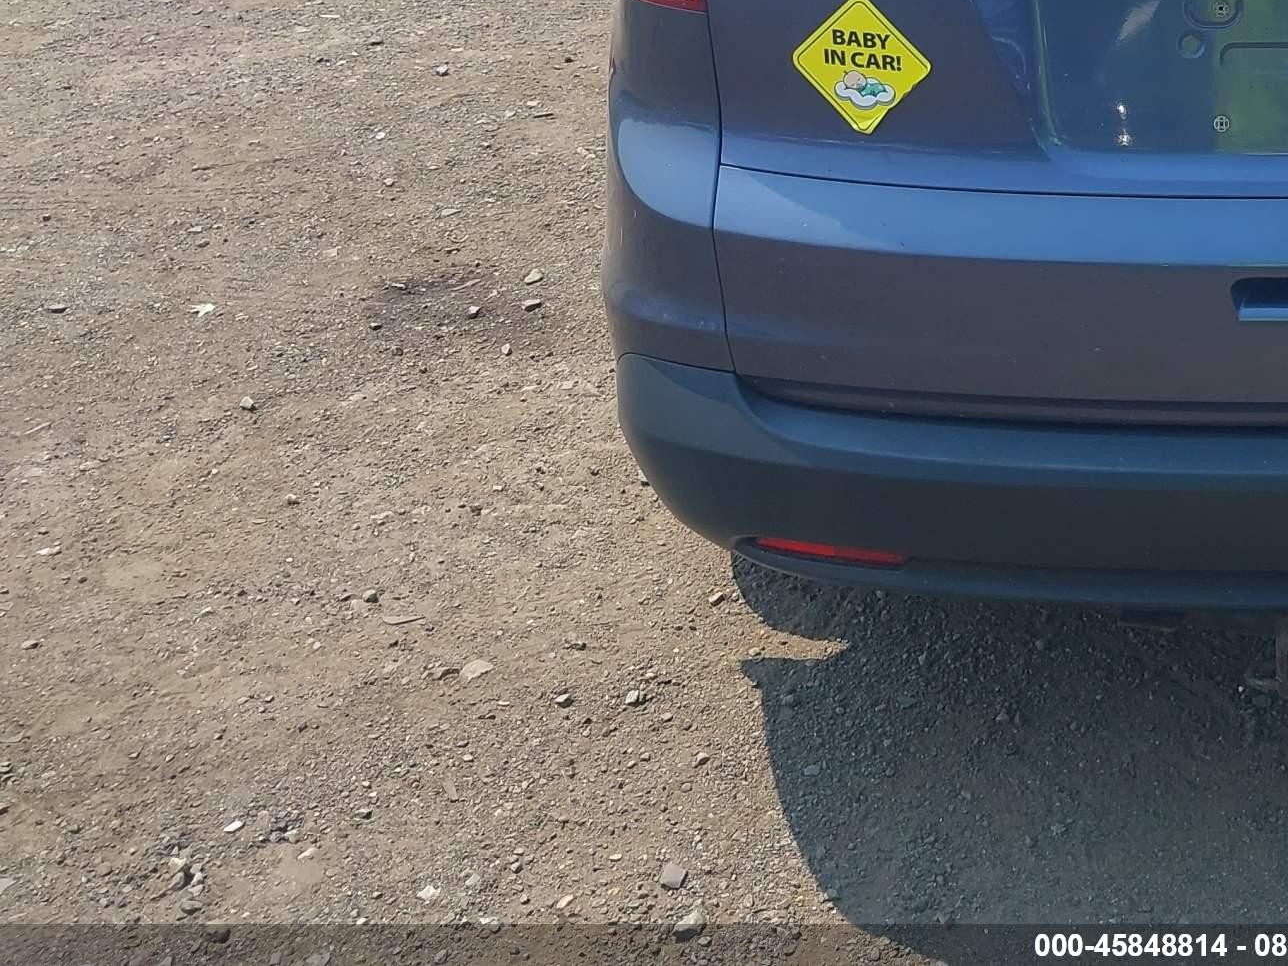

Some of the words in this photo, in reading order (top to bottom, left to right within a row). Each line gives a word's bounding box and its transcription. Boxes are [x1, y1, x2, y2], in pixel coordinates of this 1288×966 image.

[831, 28, 892, 51] BABY
[824, 48, 846, 66] IN
[850, 51, 902, 72] CAR!
